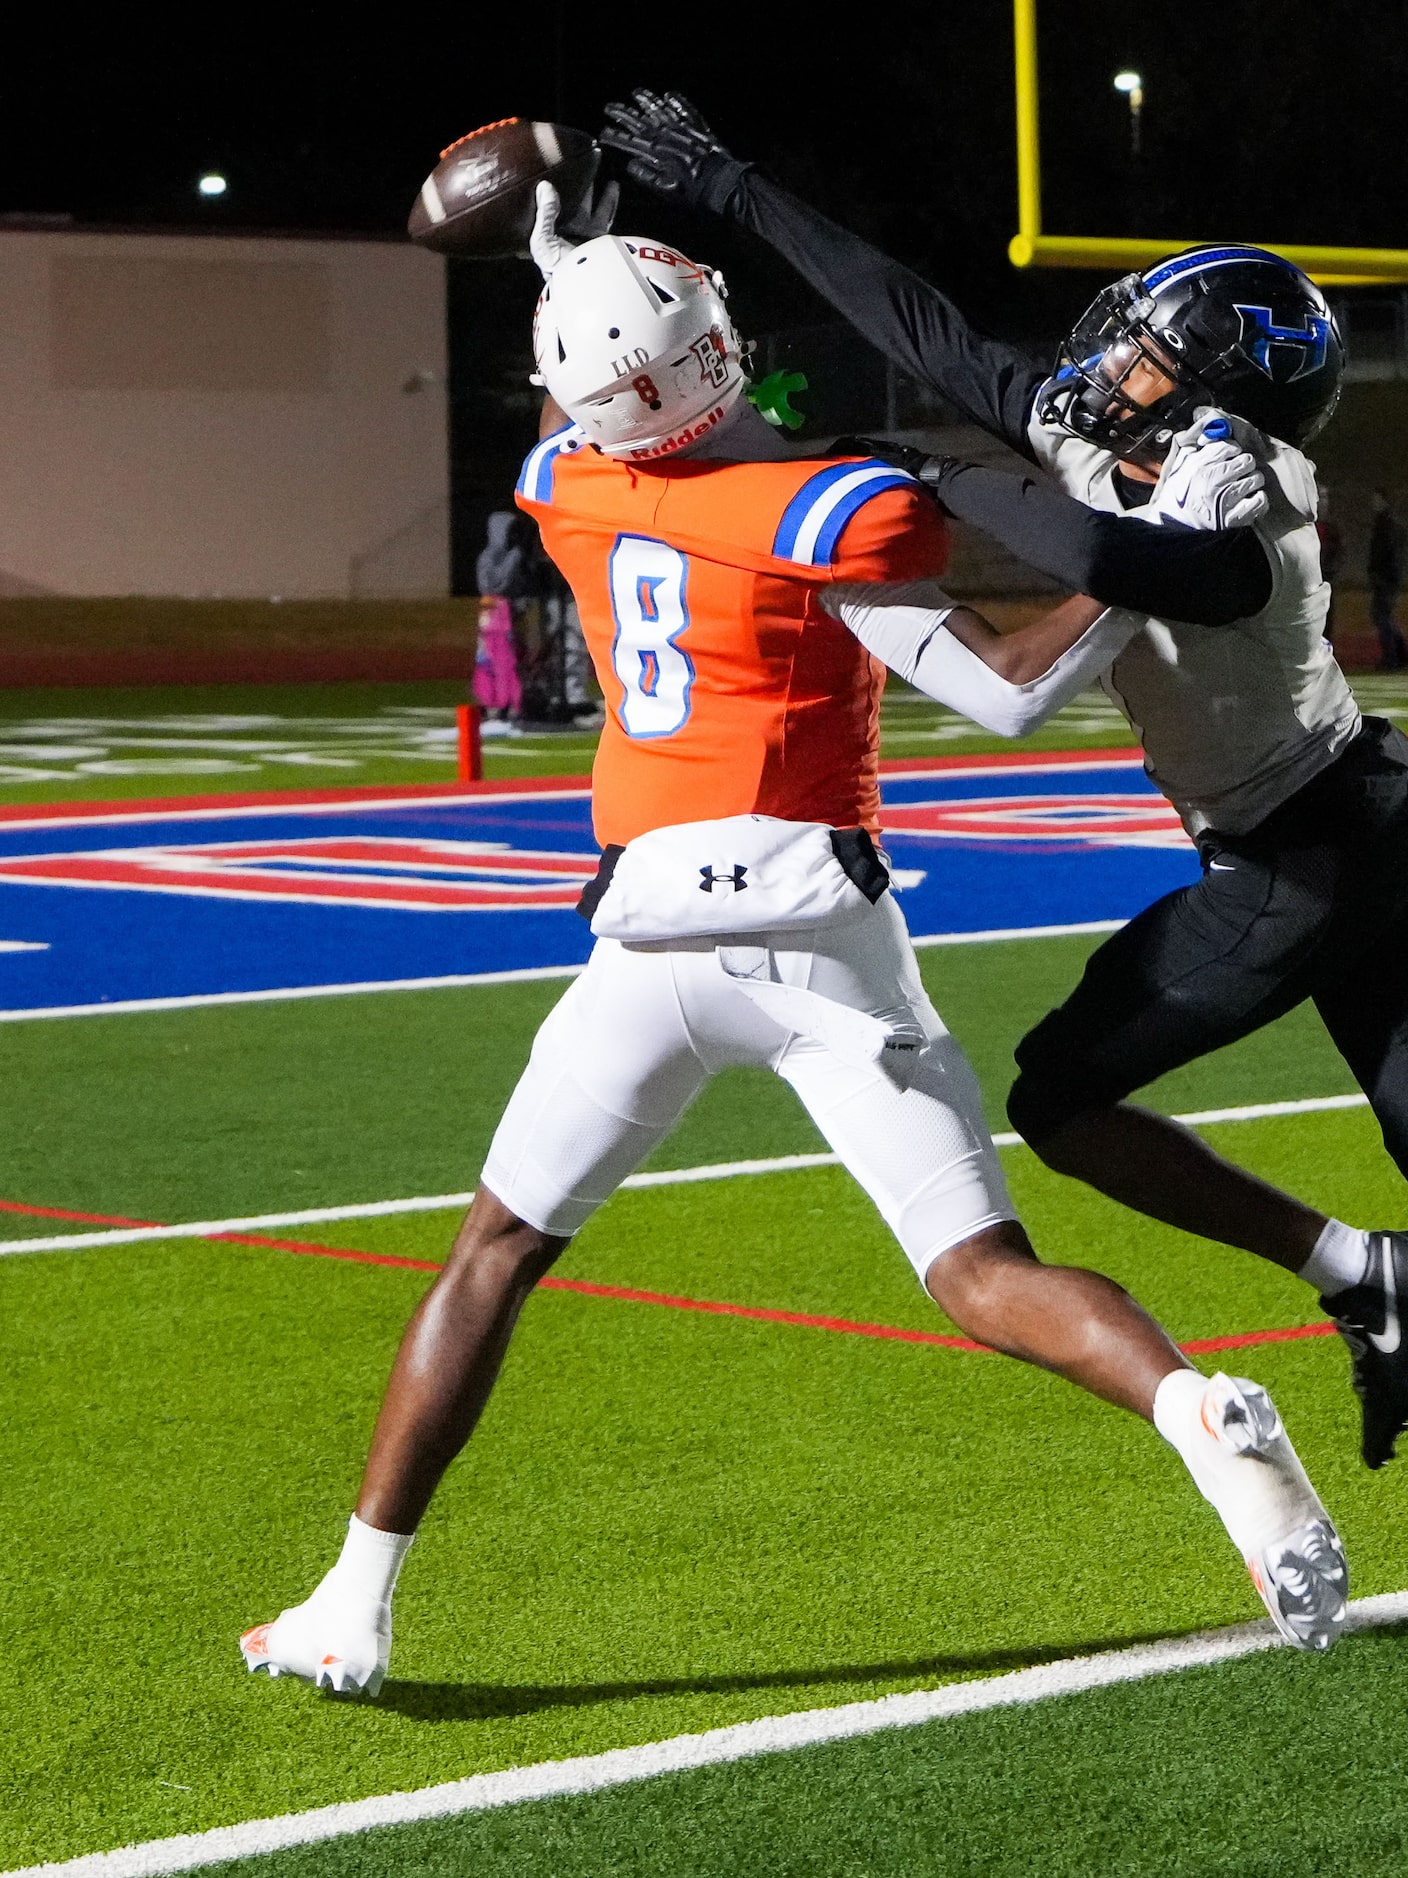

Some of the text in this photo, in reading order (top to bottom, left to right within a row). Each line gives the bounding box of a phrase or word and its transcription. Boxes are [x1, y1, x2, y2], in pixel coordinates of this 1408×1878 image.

[610, 347, 650, 378] LLD
[632, 374, 659, 404] 8
[630, 406, 724, 460] Riddell
[608, 532, 696, 739] 8
